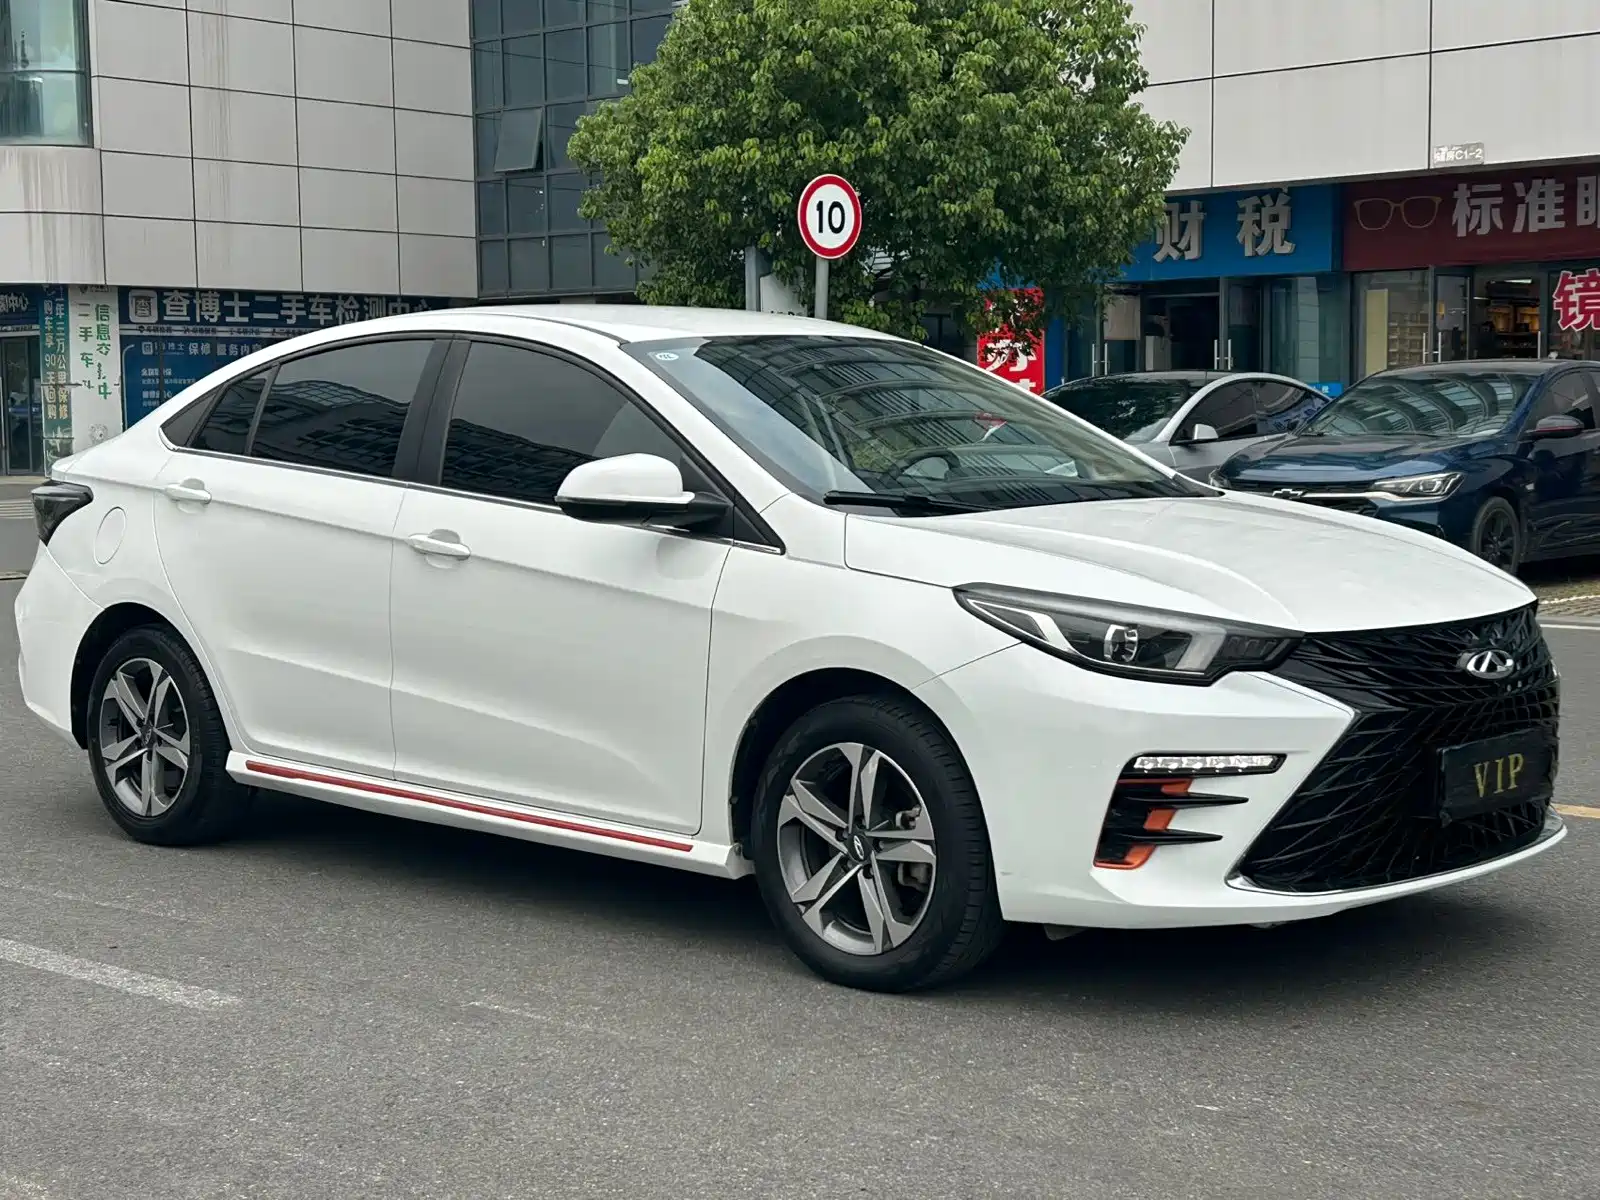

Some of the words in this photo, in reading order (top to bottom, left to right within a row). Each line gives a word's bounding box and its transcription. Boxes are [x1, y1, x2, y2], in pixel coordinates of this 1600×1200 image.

[816, 200, 846, 234] 10
[1153, 193, 1296, 263] 财税
[1473, 753, 1524, 798] VIP
